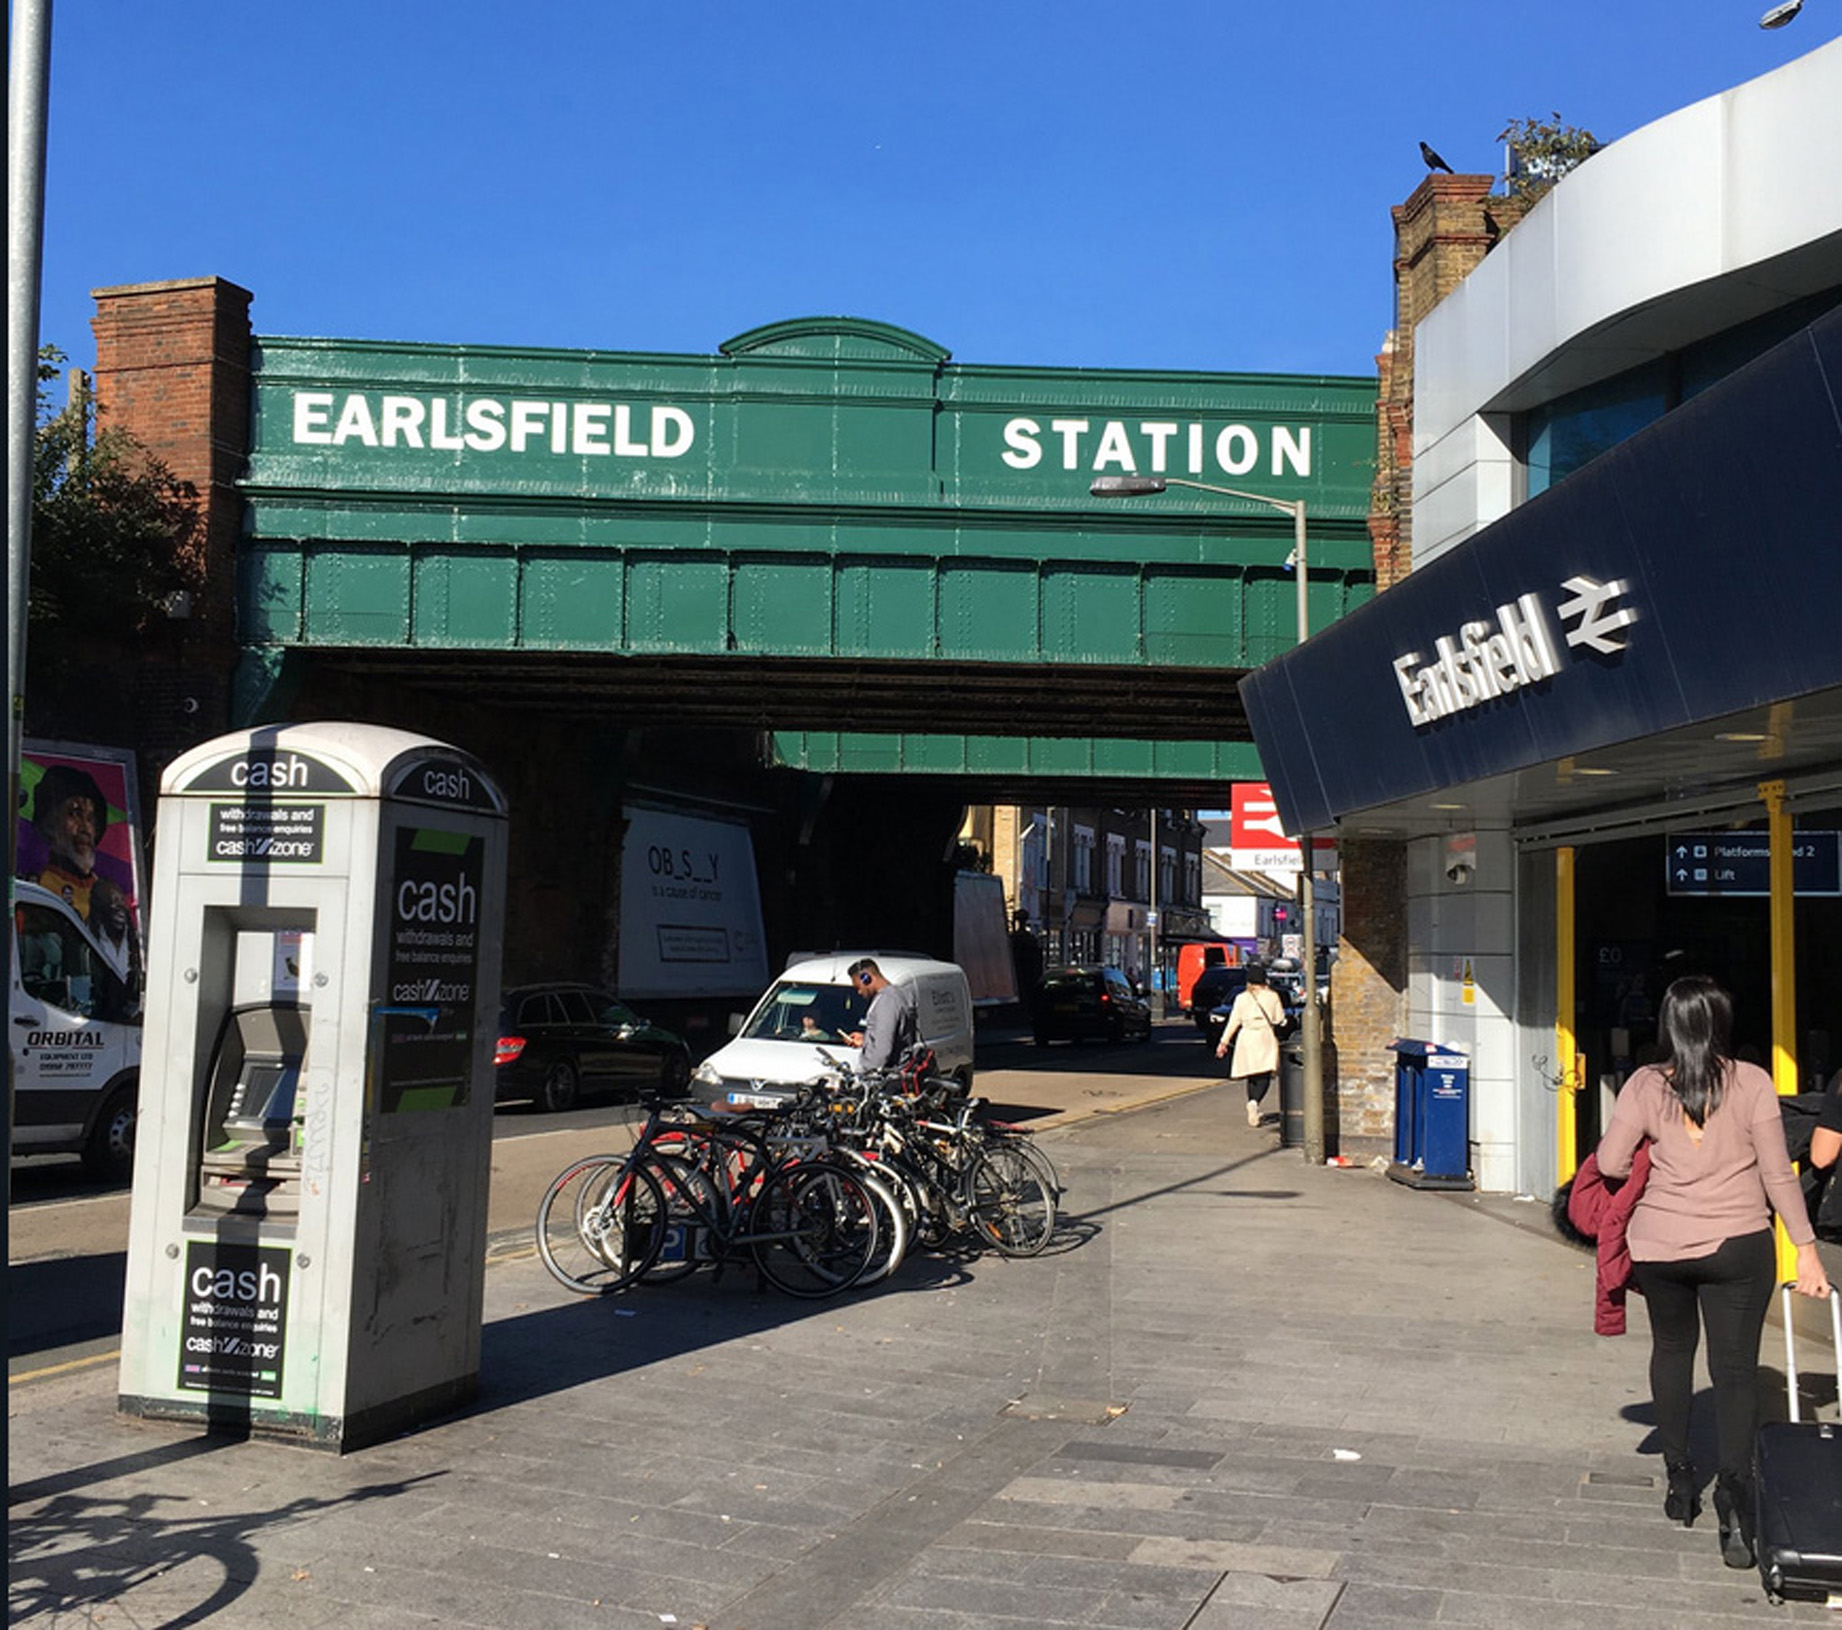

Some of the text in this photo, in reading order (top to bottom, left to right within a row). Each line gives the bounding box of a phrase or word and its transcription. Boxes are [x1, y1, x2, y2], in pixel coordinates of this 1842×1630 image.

[292, 392, 695, 458] EARLSFIELD
[1001, 418, 1311, 477] STATION
[1393, 593, 1562, 726] Earlsfield
[231, 755, 308, 787] cash
[424, 769, 469, 799] cash
[220, 808, 314, 821] withdrawals and
[220, 823, 313, 835] free balance enquiries
[1255, 854, 1301, 866] Earlsfiel
[1806, 846, 1815, 857] 2
[1714, 869, 1735, 880] Lift
[398, 872, 475, 923] cash
[396, 929, 473, 947] withdrawals and
[27, 1032, 104, 1046] ORBITAL
[192, 1263, 281, 1302] cash
[191, 1302, 278, 1320] withdrawals and
[190, 1316, 206, 1326] free
[208, 1318, 238, 1329] balance
